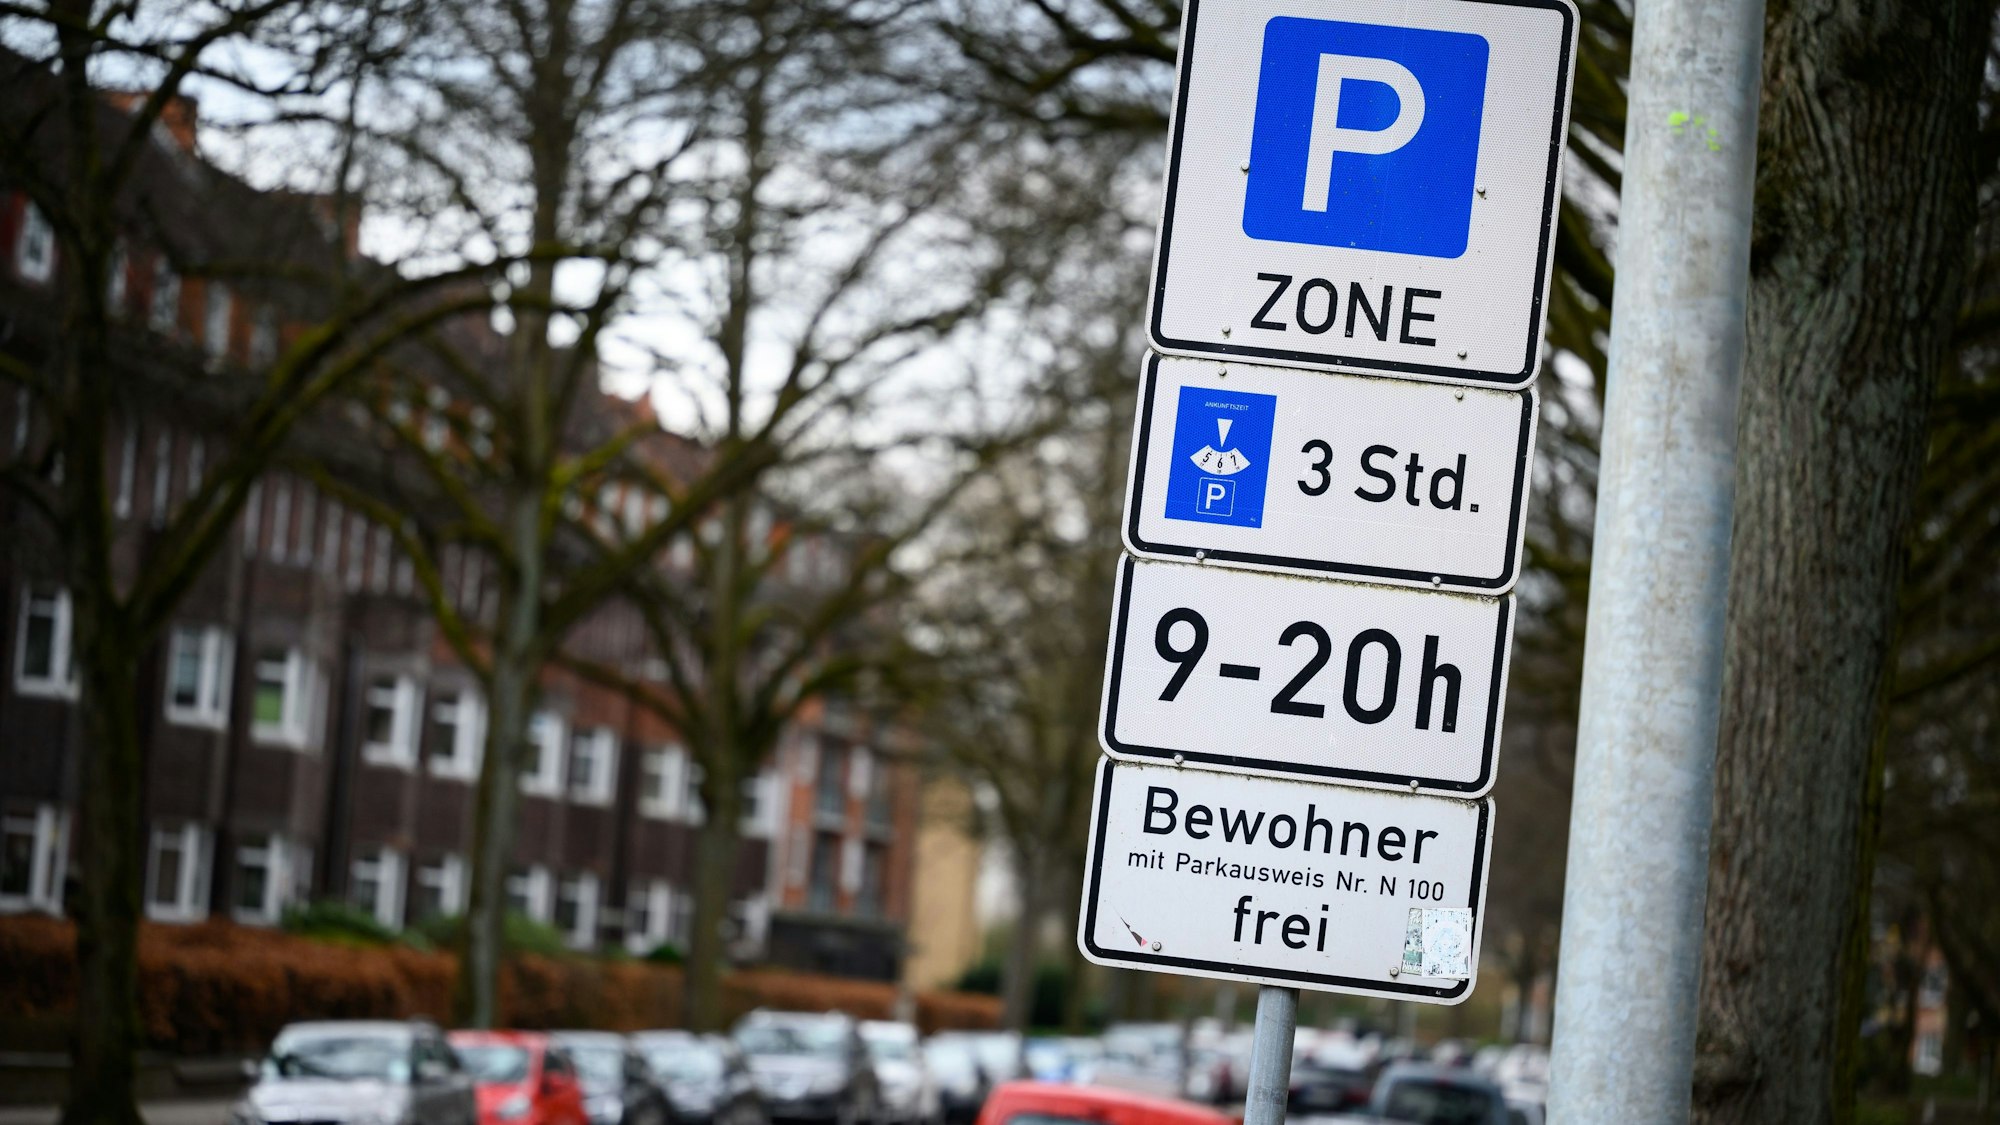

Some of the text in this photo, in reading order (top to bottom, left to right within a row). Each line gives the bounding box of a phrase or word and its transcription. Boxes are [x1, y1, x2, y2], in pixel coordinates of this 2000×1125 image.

[1302, 53, 1426, 212] P
[1250, 272, 1442, 347] ZONE
[1204, 401, 1250, 411] ANKUNFTSZEIT
[1202, 452, 1212, 463] 5
[1217, 457, 1223, 469] 6
[1230, 454, 1238, 466] 7
[1297, 439, 1480, 513] 3 Std.
[1205, 483, 1226, 510] P
[1154, 607, 1462, 734] 9-20h
[1142, 785, 1439, 864] Bewohner
[1128, 850, 1445, 902] mit Parkausweis Nr. N 100
[1233, 895, 1329, 952] frei
